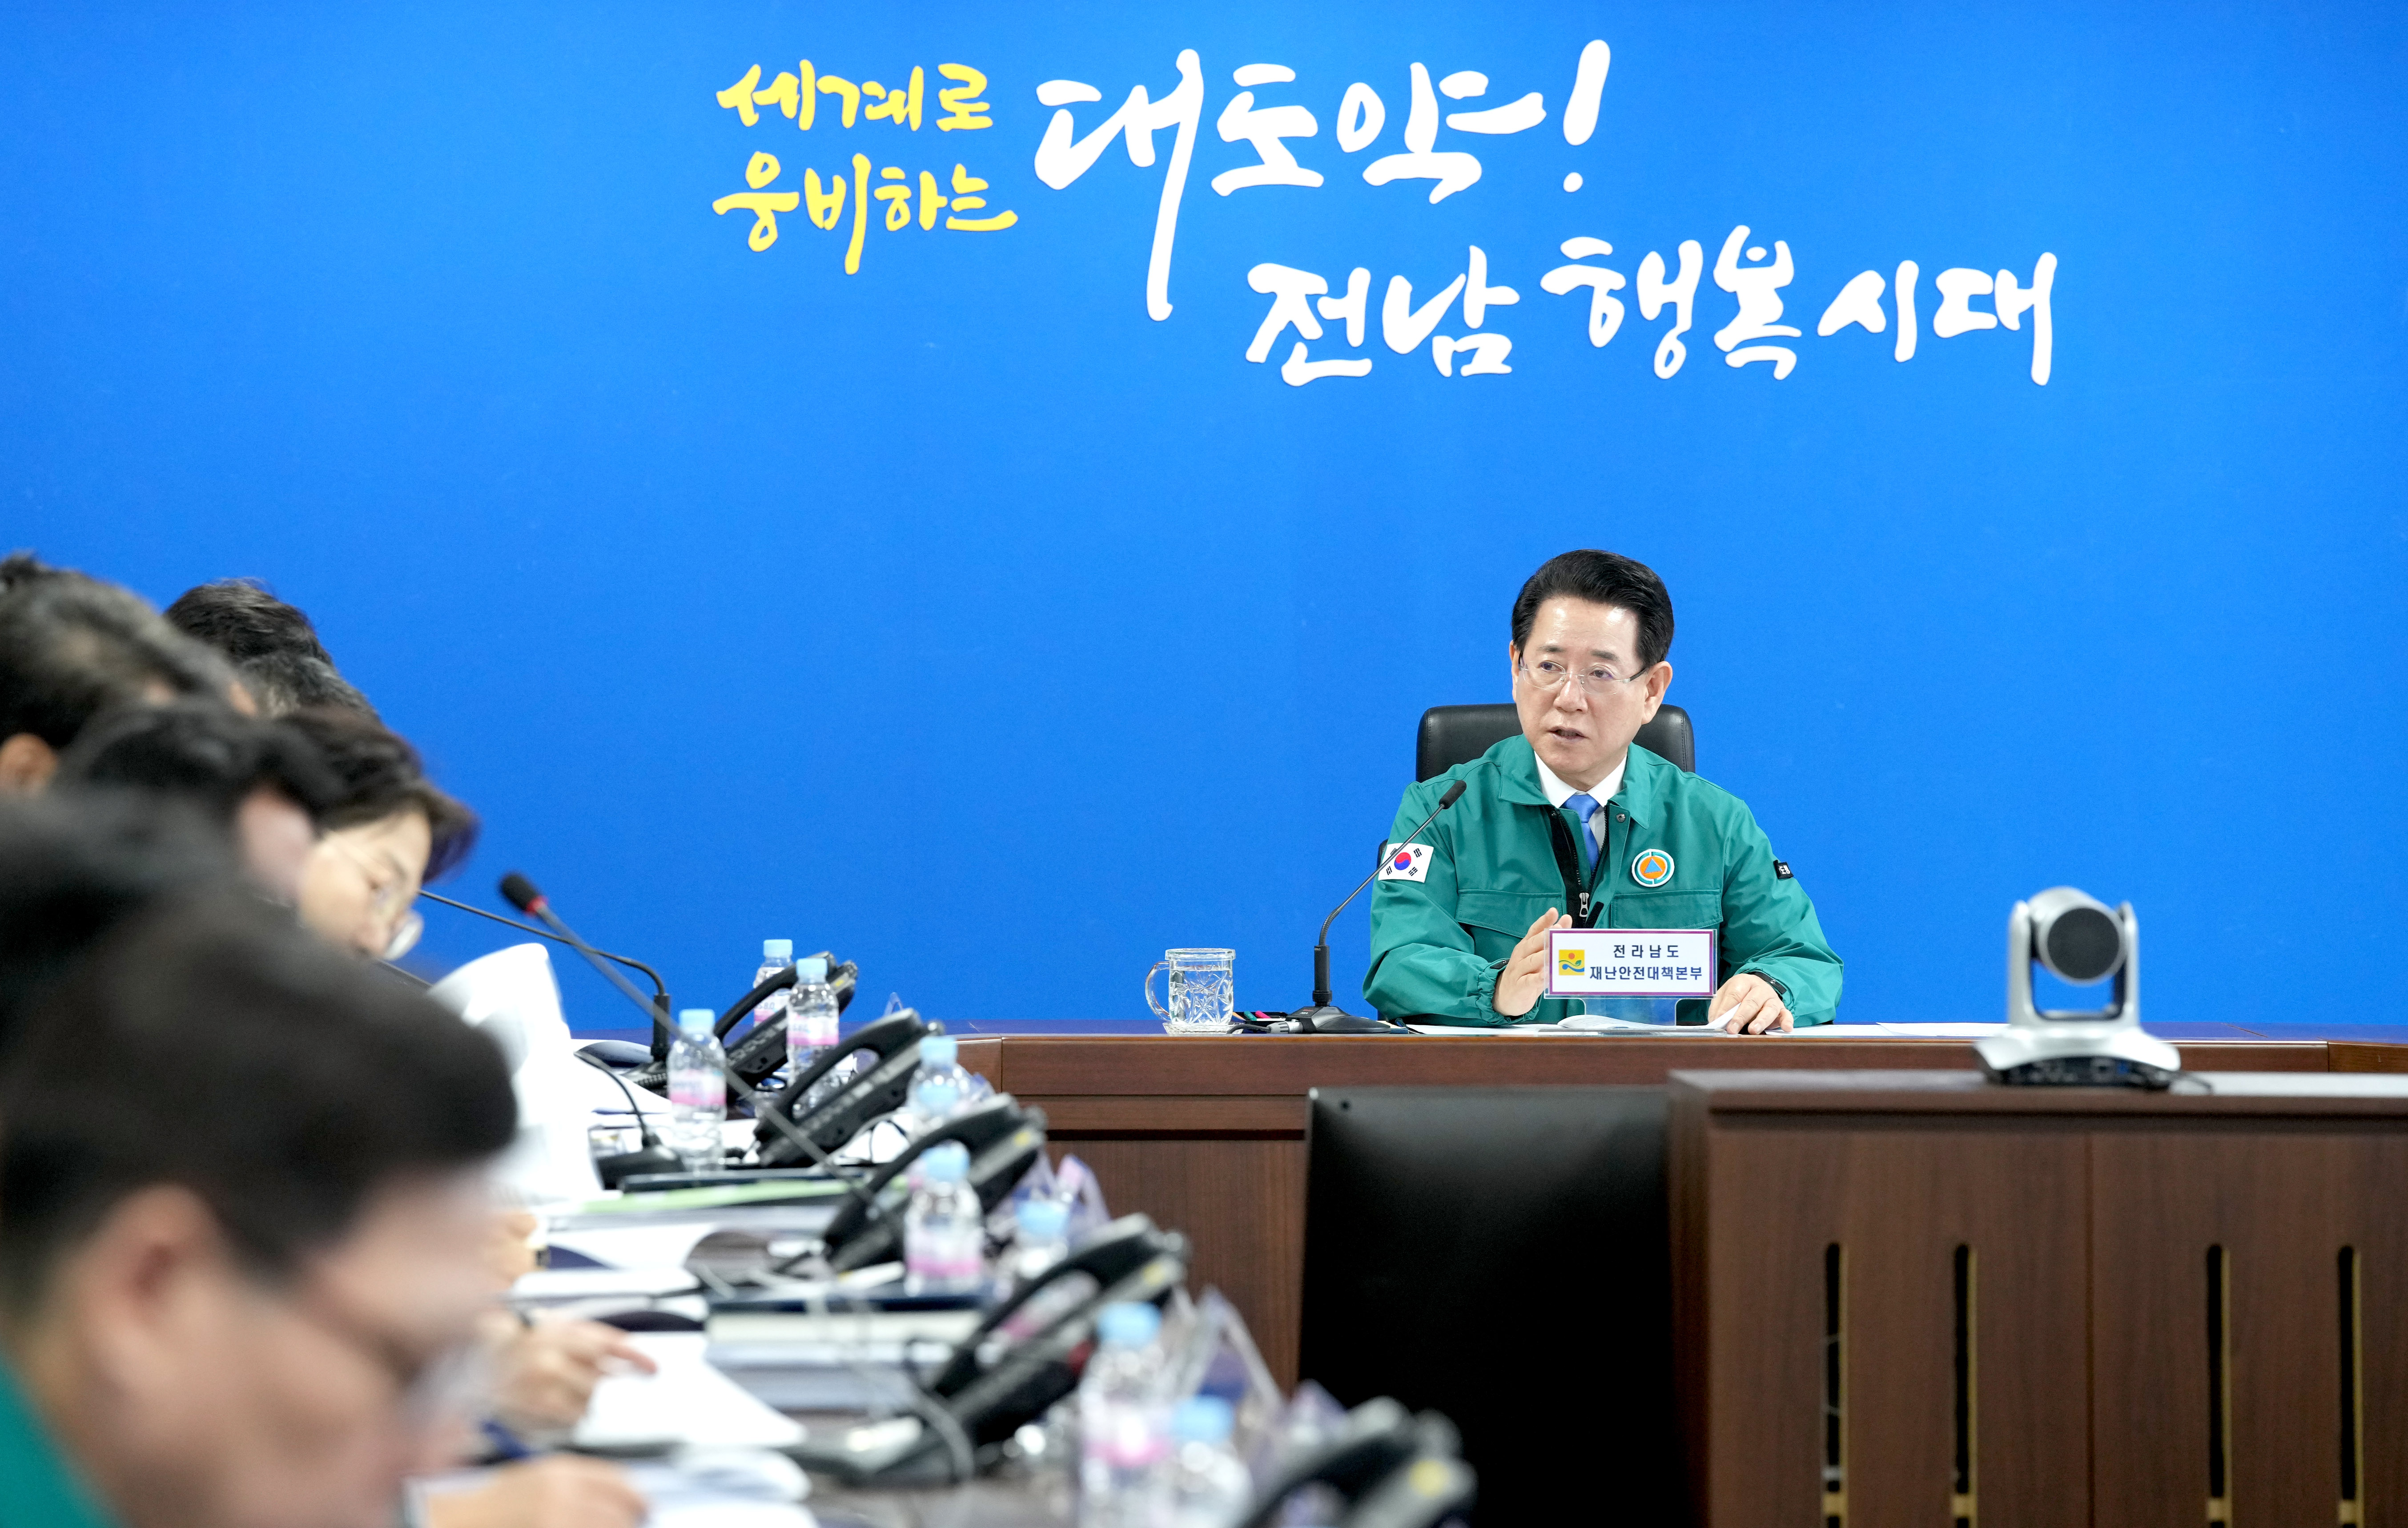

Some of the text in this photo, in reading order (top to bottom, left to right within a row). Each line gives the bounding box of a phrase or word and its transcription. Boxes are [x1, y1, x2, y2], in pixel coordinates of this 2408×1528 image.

[716, 59, 993, 132] 세계로
[712, 151, 1018, 275] 웅비하는
[1246, 245, 1520, 387] 전남
[1589, 966, 1702, 980] 재난안전대책본부
[1613, 944, 1679, 958] 전라남도
